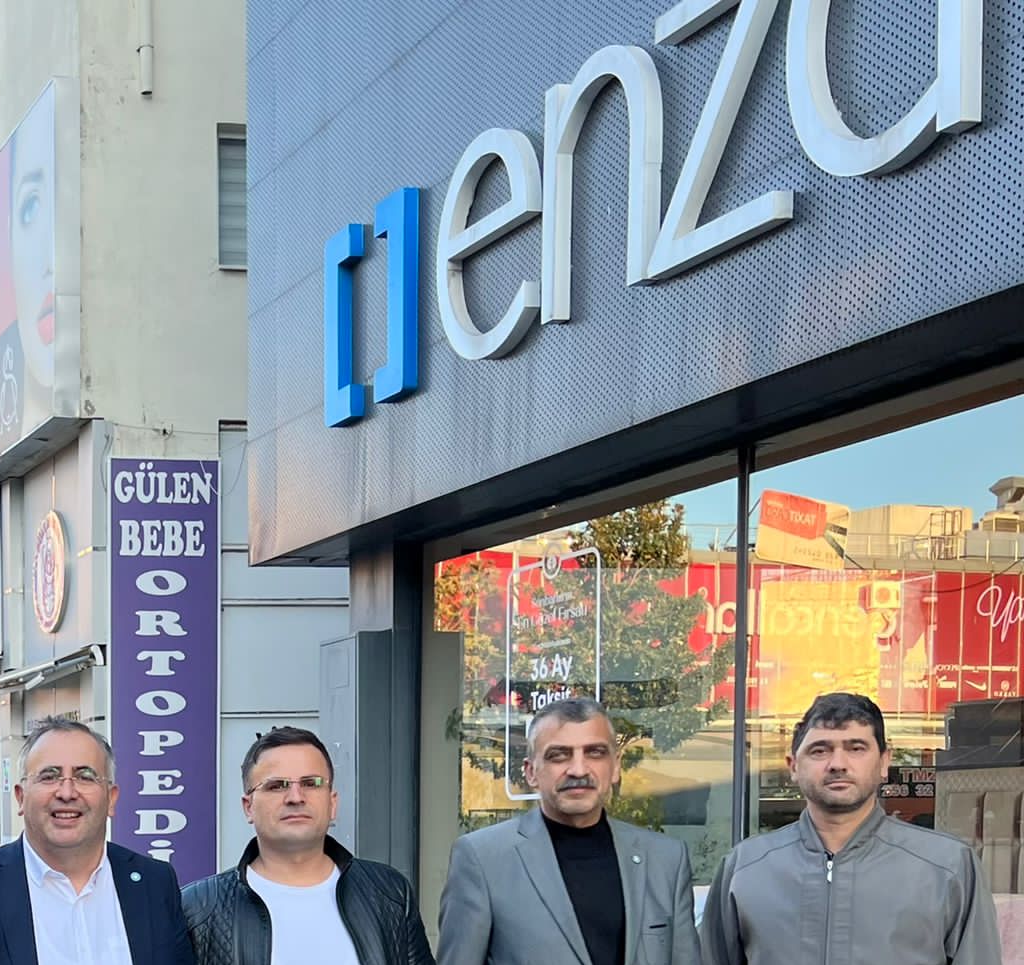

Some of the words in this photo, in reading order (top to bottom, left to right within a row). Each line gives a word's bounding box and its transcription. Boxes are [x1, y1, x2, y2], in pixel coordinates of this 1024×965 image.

[114, 463, 214, 505] GÜLEN
[119, 520, 206, 557] BEBE
[530, 657, 548, 681] 36
[552, 653, 573, 680] Ay
